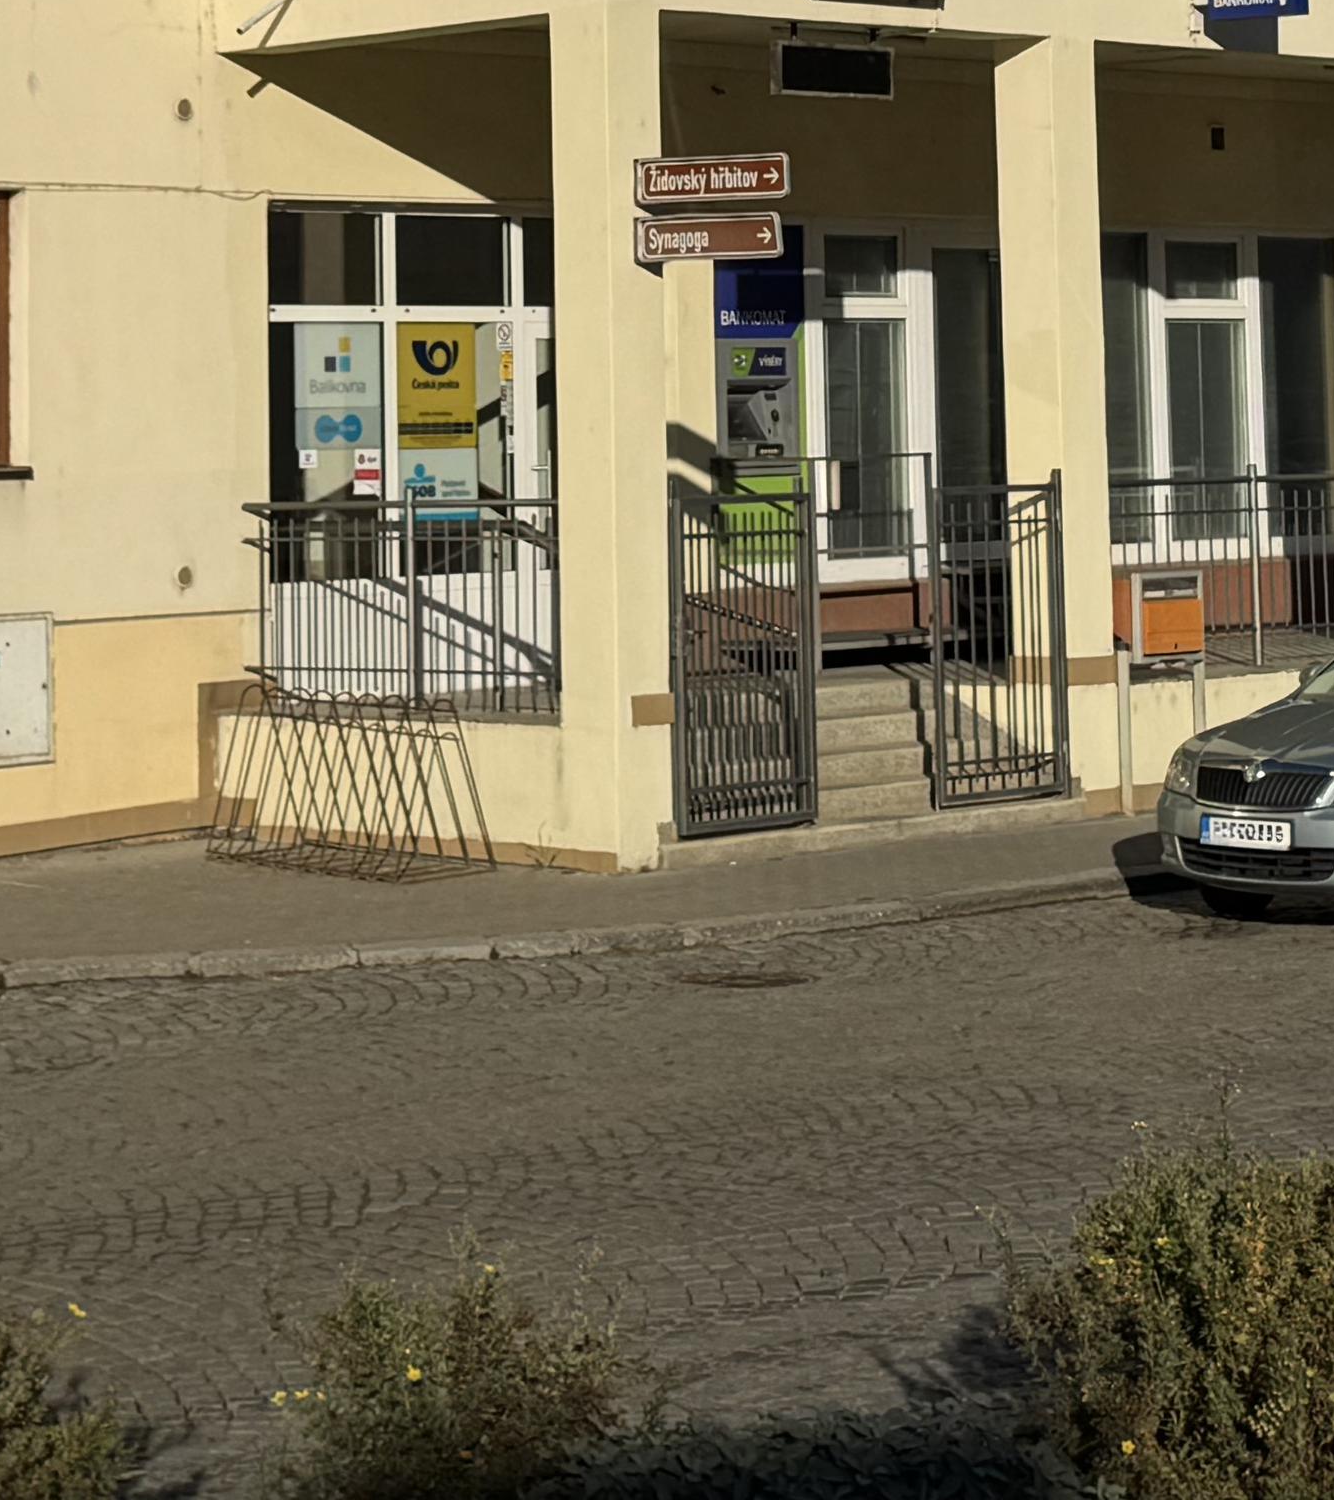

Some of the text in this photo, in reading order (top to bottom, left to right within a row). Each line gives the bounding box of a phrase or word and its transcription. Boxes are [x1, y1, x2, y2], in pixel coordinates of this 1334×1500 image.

[649, 165, 759, 195] Židovský hřbitov
[648, 227, 709, 254] Synagoga
[720, 309, 786, 326] BANKOMAT
